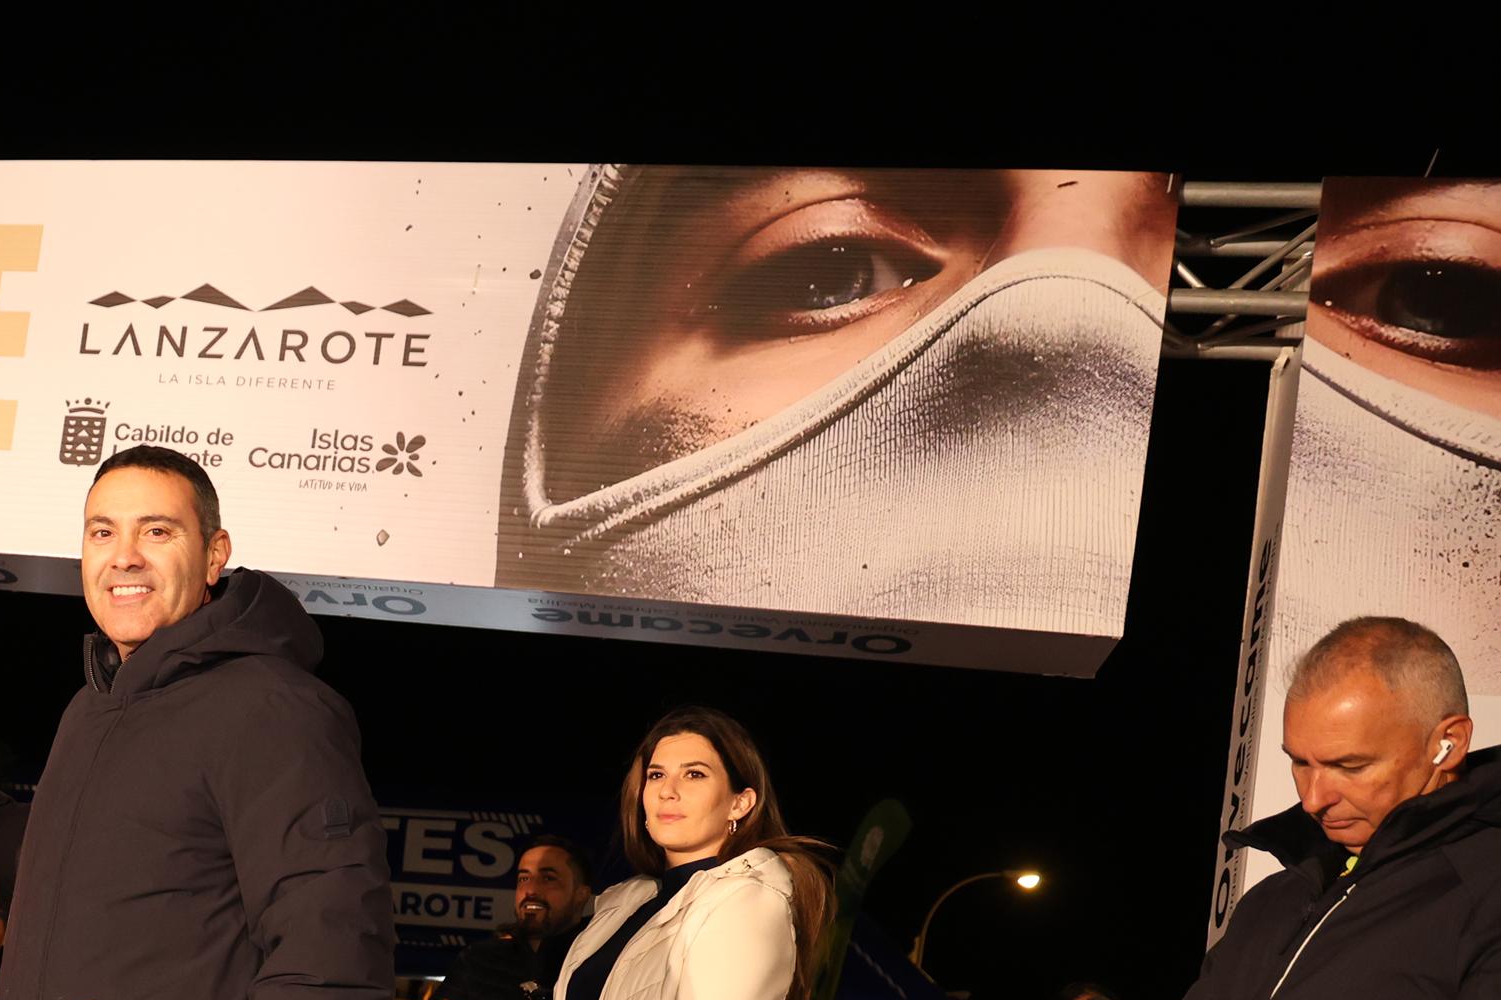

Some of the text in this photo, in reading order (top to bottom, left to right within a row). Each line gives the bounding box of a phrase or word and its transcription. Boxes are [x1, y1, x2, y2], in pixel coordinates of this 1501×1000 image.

[78, 322, 431, 367] LANZAROTE
[158, 373, 337, 391] LA ISLA DIFERENTE
[115, 423, 234, 446] Cabildo de
[310, 428, 374, 452] Islas
[248, 447, 372, 473] Canarias
[336, 482, 346, 491] DE
[293, 588, 427, 615] Orv
[532, 607, 912, 655] Orvecame
[392, 891, 494, 920] ROTE
